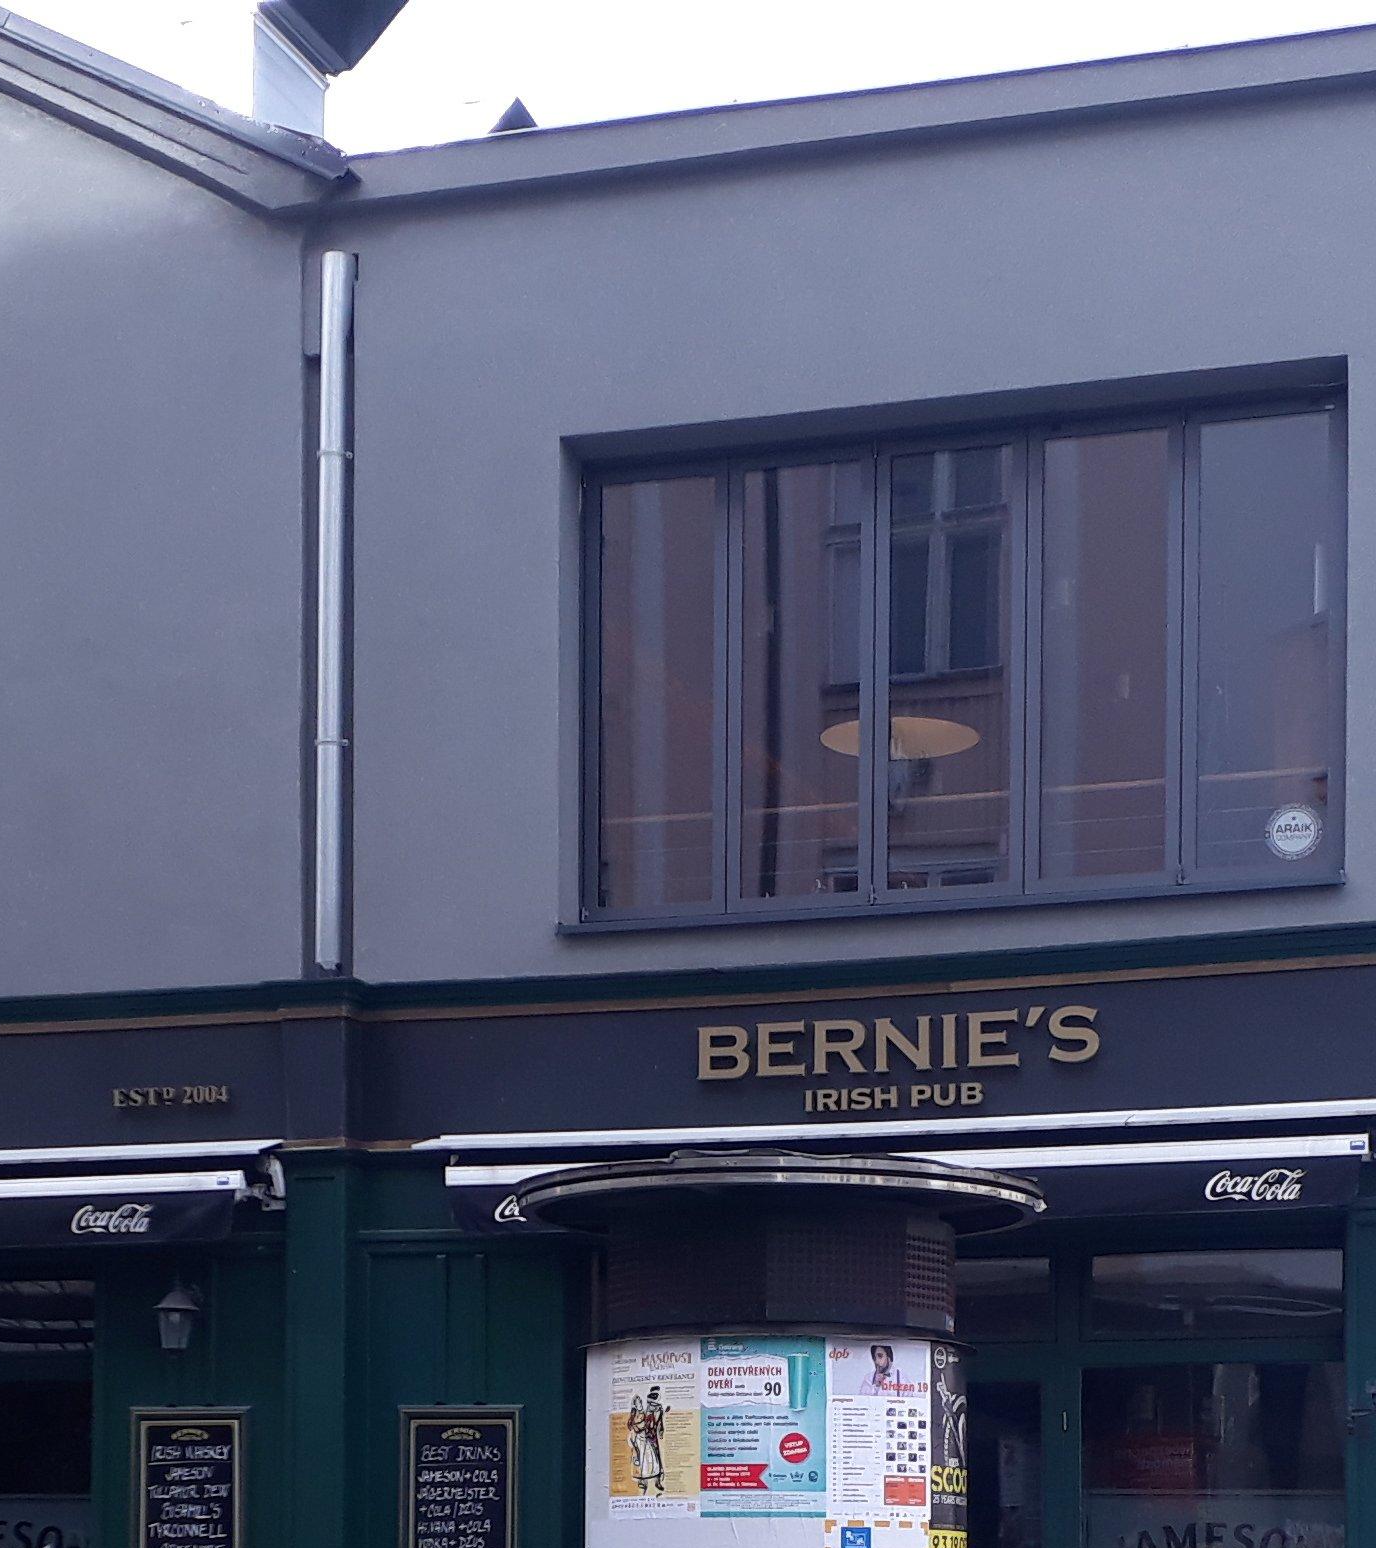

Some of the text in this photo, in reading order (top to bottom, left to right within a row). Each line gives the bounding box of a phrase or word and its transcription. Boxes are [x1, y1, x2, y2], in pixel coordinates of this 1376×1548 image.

[697, 1004, 1101, 1081] BERNIE'S
[182, 1085, 230, 1105] 2004
[804, 1082, 986, 1113] IRISH PUB
[708, 1365, 782, 1376] DEN OTEVŘENÝCH
[764, 1382, 782, 1397] 90
